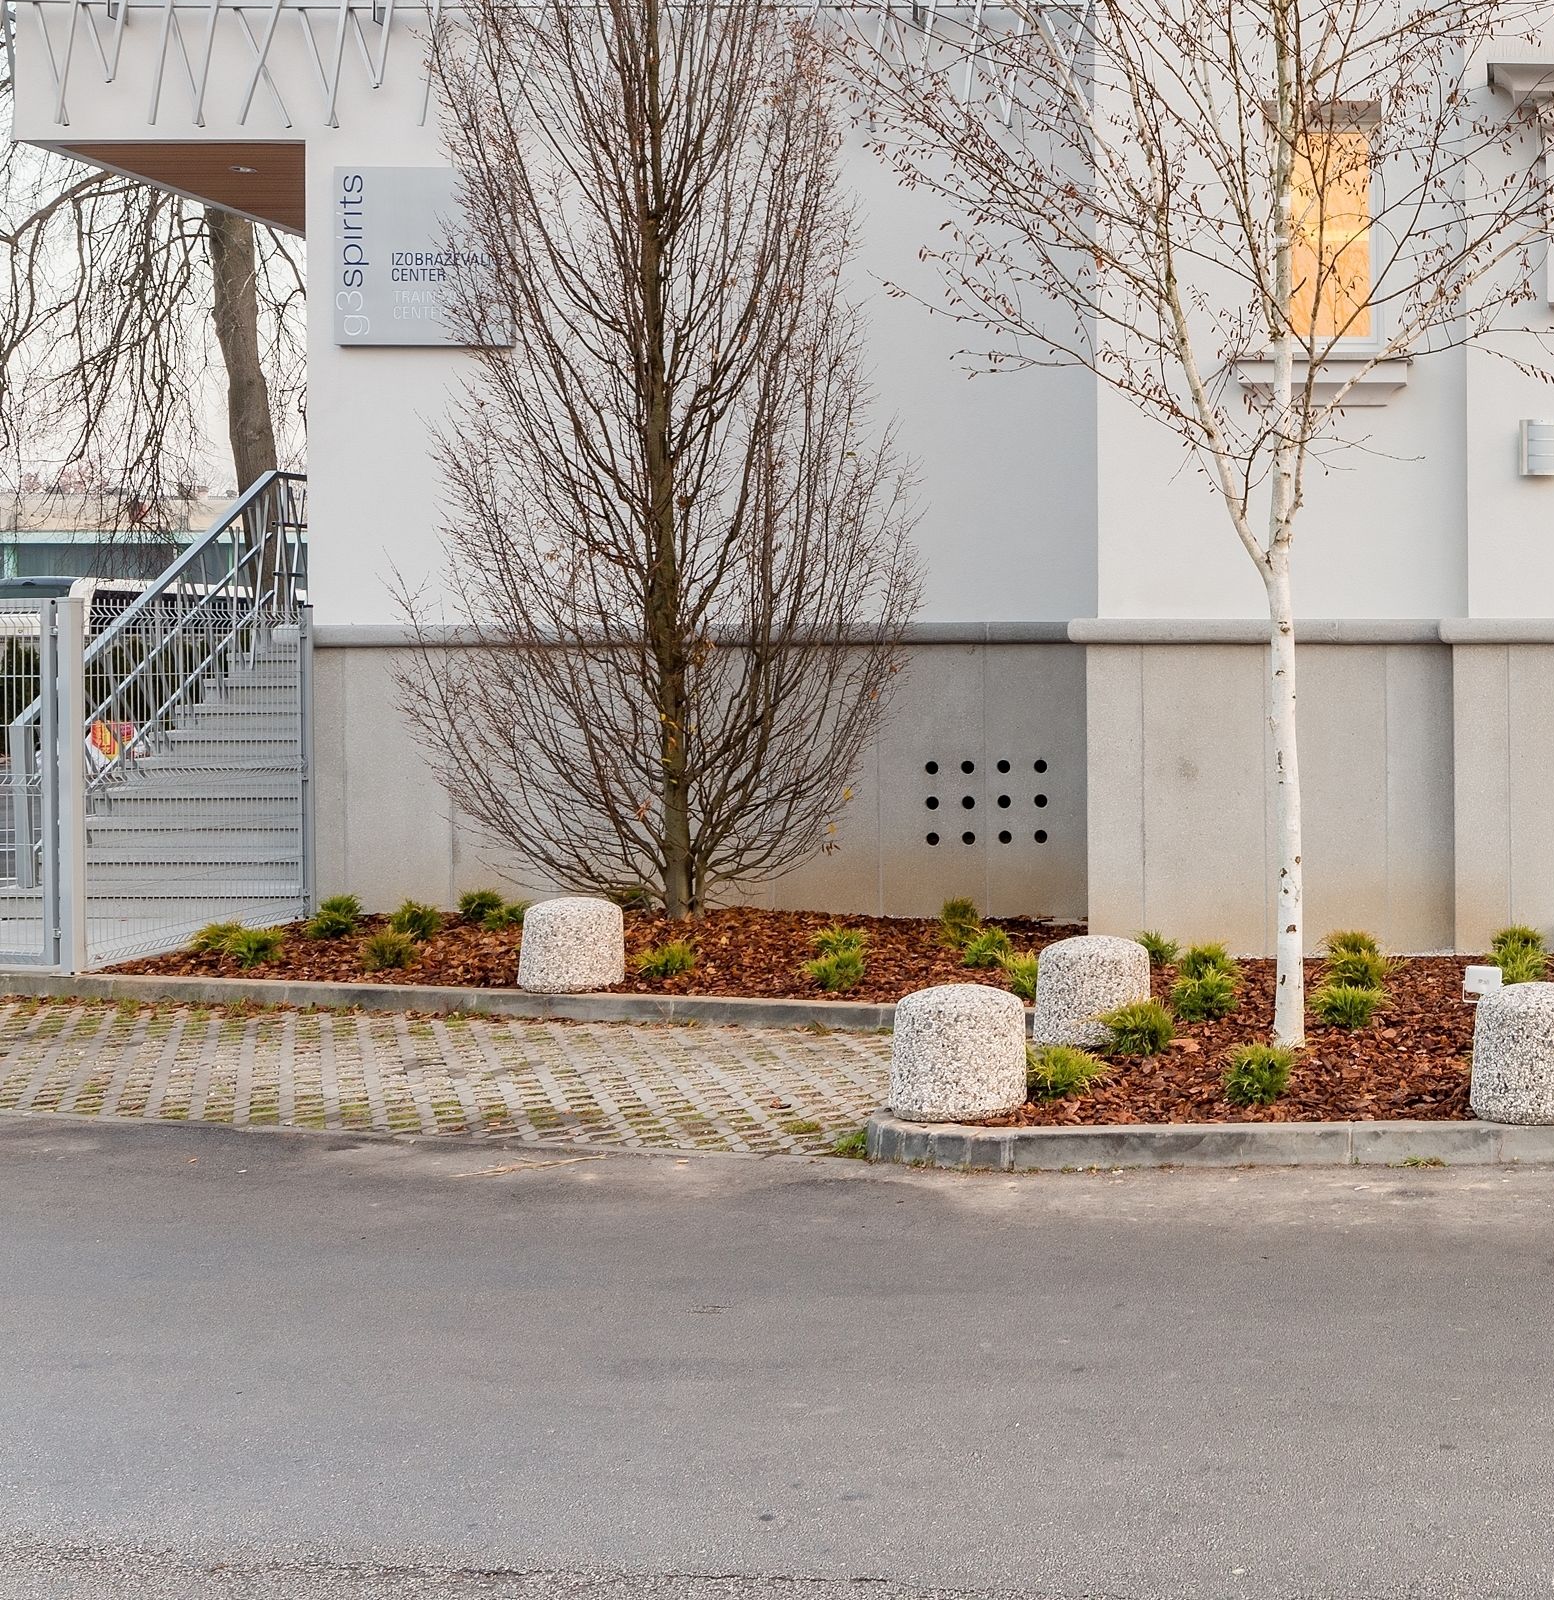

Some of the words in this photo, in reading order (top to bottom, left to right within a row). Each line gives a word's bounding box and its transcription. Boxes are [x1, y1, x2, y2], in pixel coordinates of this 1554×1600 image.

[336, 174, 370, 336] g3spirits
[391, 249, 502, 266] IZOBRAŽEVAL
[391, 268, 446, 282] CENTER
[392, 290, 456, 304] TRAIN
[393, 306, 447, 320] CENTER
